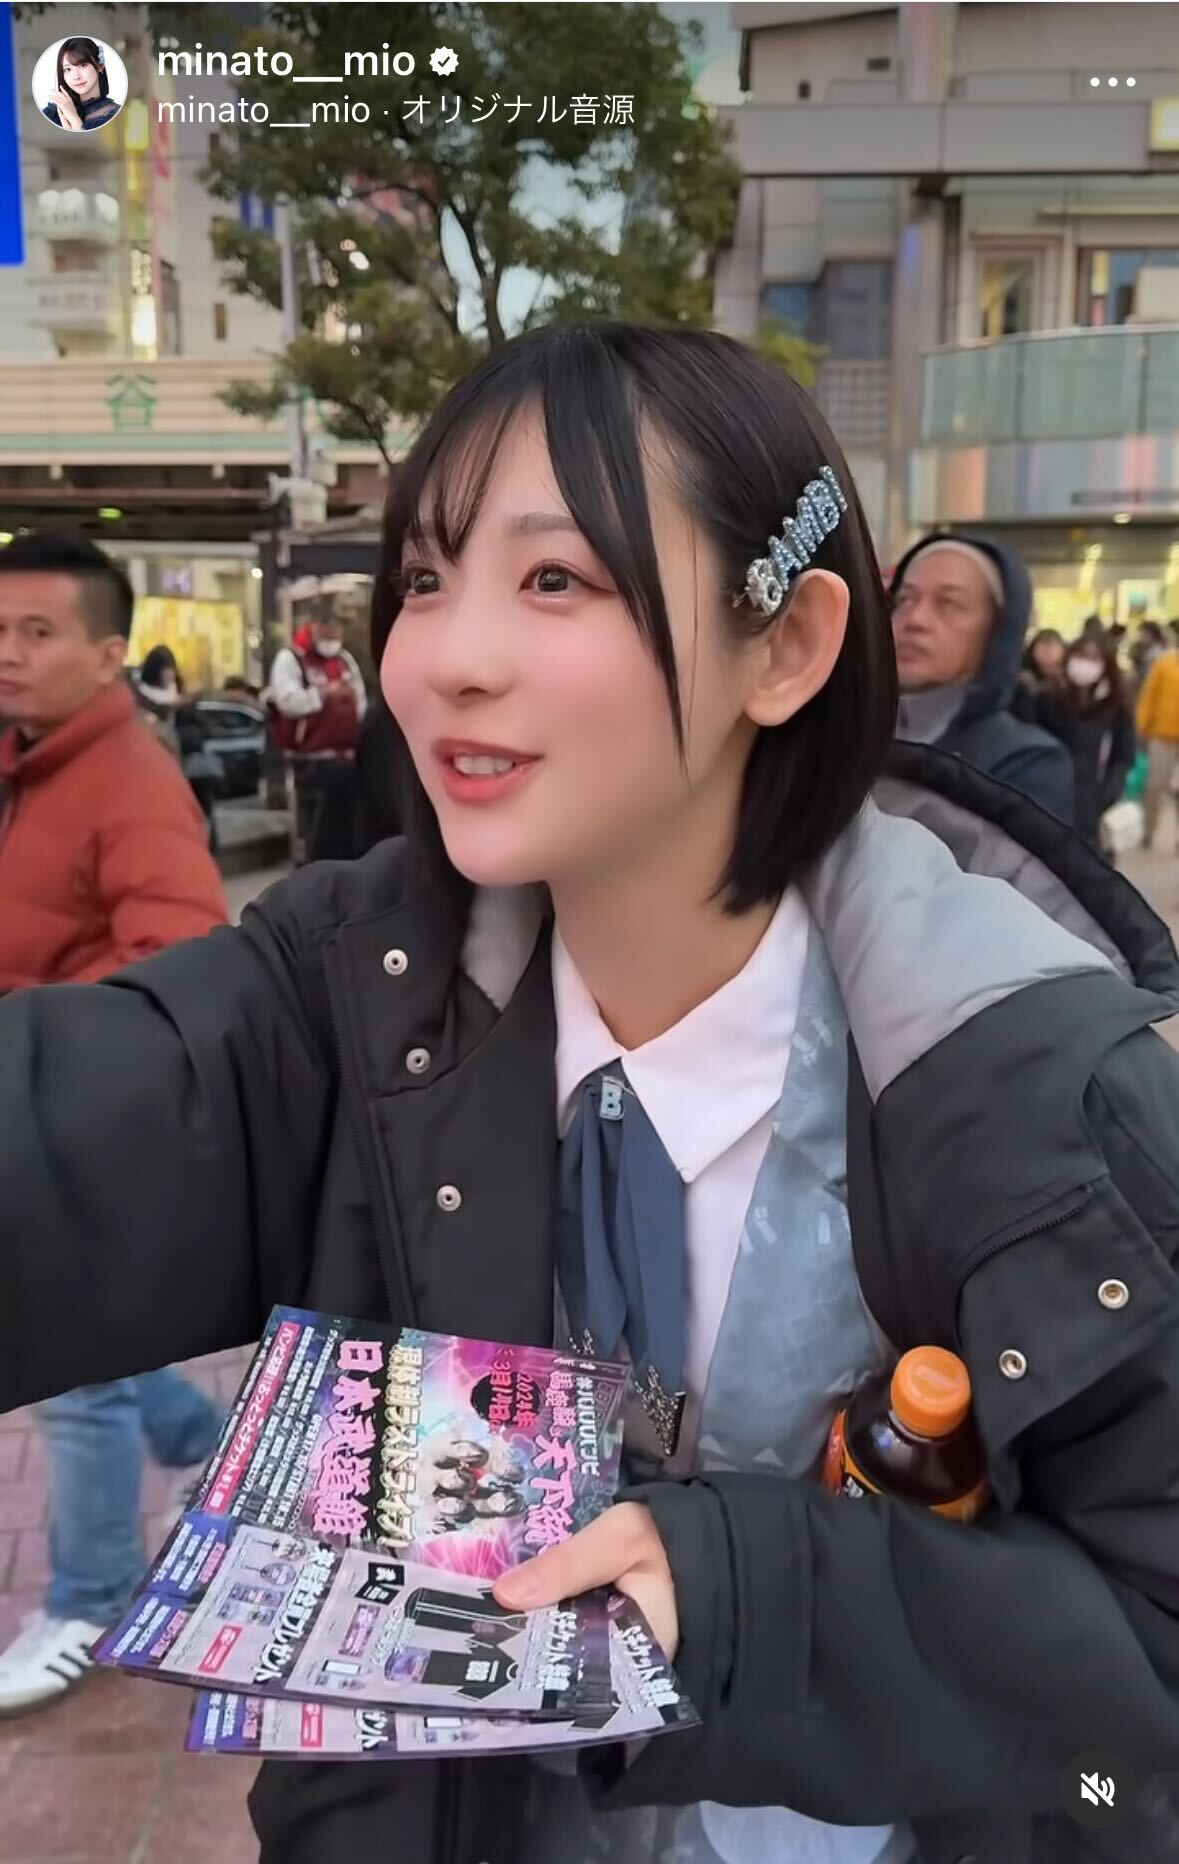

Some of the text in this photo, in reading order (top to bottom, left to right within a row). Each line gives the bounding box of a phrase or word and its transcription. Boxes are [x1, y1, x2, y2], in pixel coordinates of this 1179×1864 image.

[107, 374, 157, 428] 谷
[311, 1338, 385, 1536] 日本武道館
